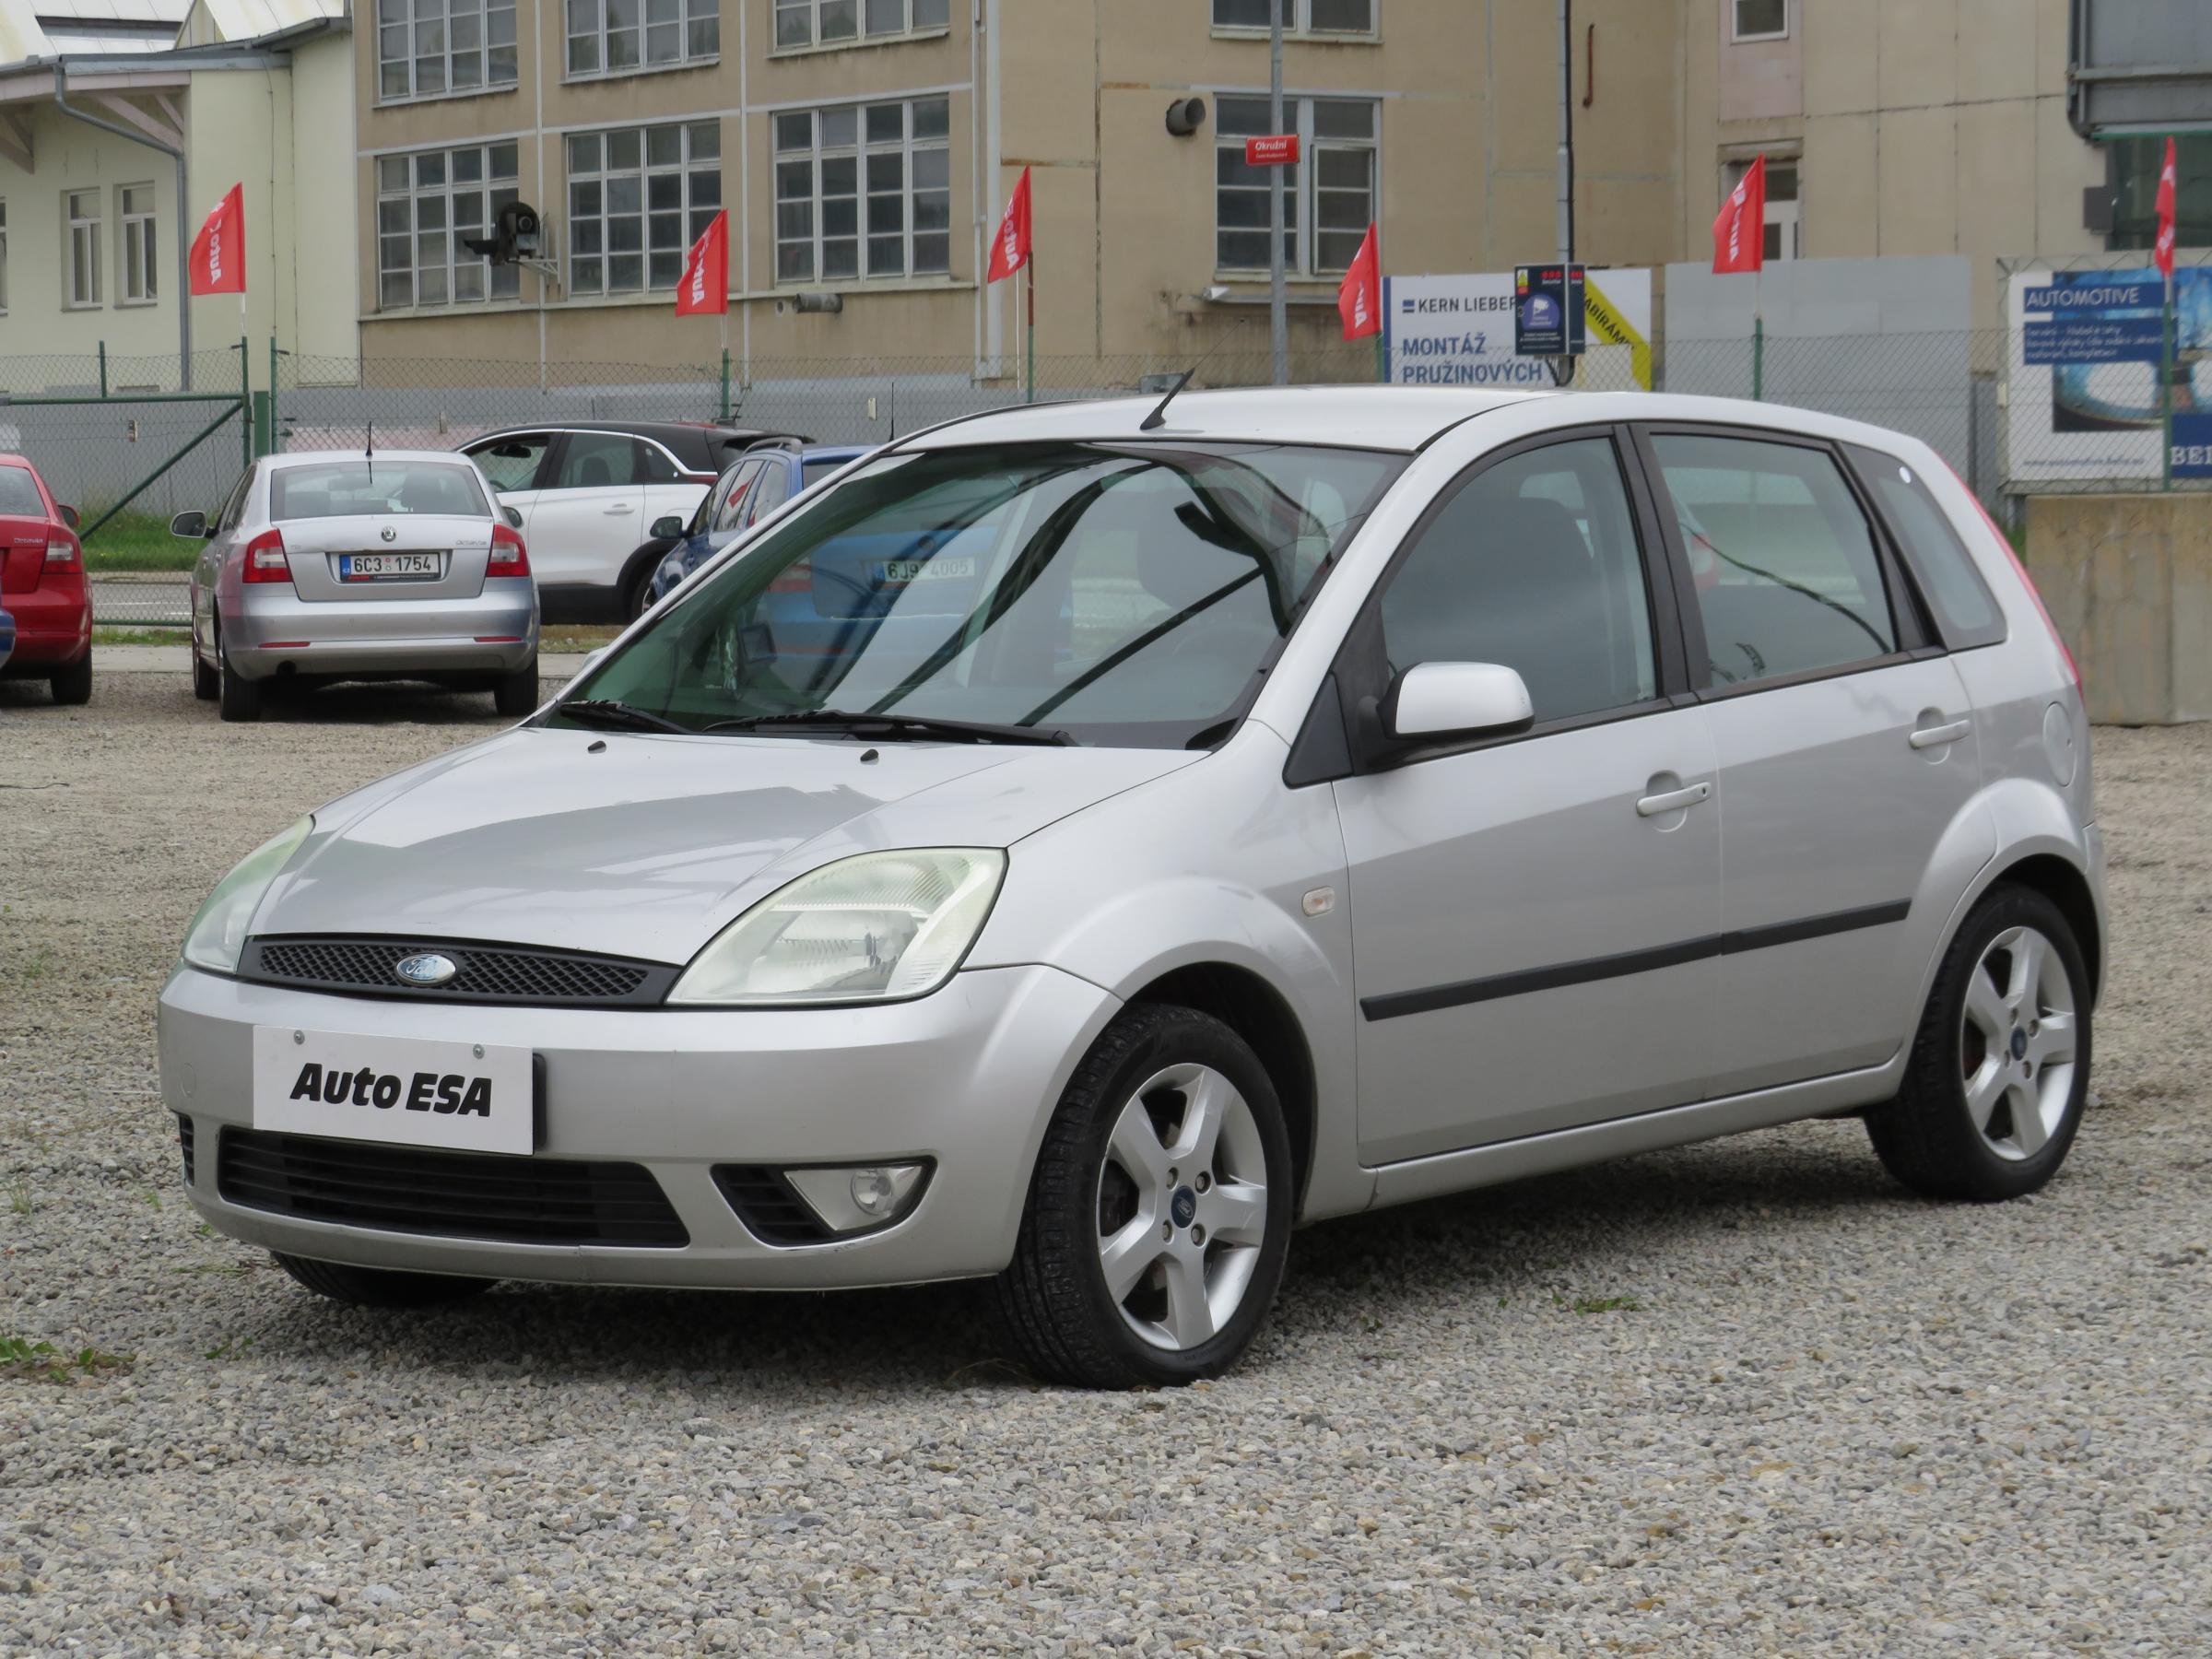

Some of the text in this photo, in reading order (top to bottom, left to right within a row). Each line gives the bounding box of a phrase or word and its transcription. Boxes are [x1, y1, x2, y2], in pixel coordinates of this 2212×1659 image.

[1418, 298, 1459, 313] KERN
[2027, 287, 2140, 307] AUTOMOTIVE
[1402, 332, 1487, 356] MONTÁŽ
[1402, 359, 1543, 383] PRUŽINOVÝCH
[354, 558, 382, 572] 6C3
[394, 556, 431, 572] 1754
[888, 562, 920, 580] 6J9
[289, 1063, 492, 1117] Auto ESA
